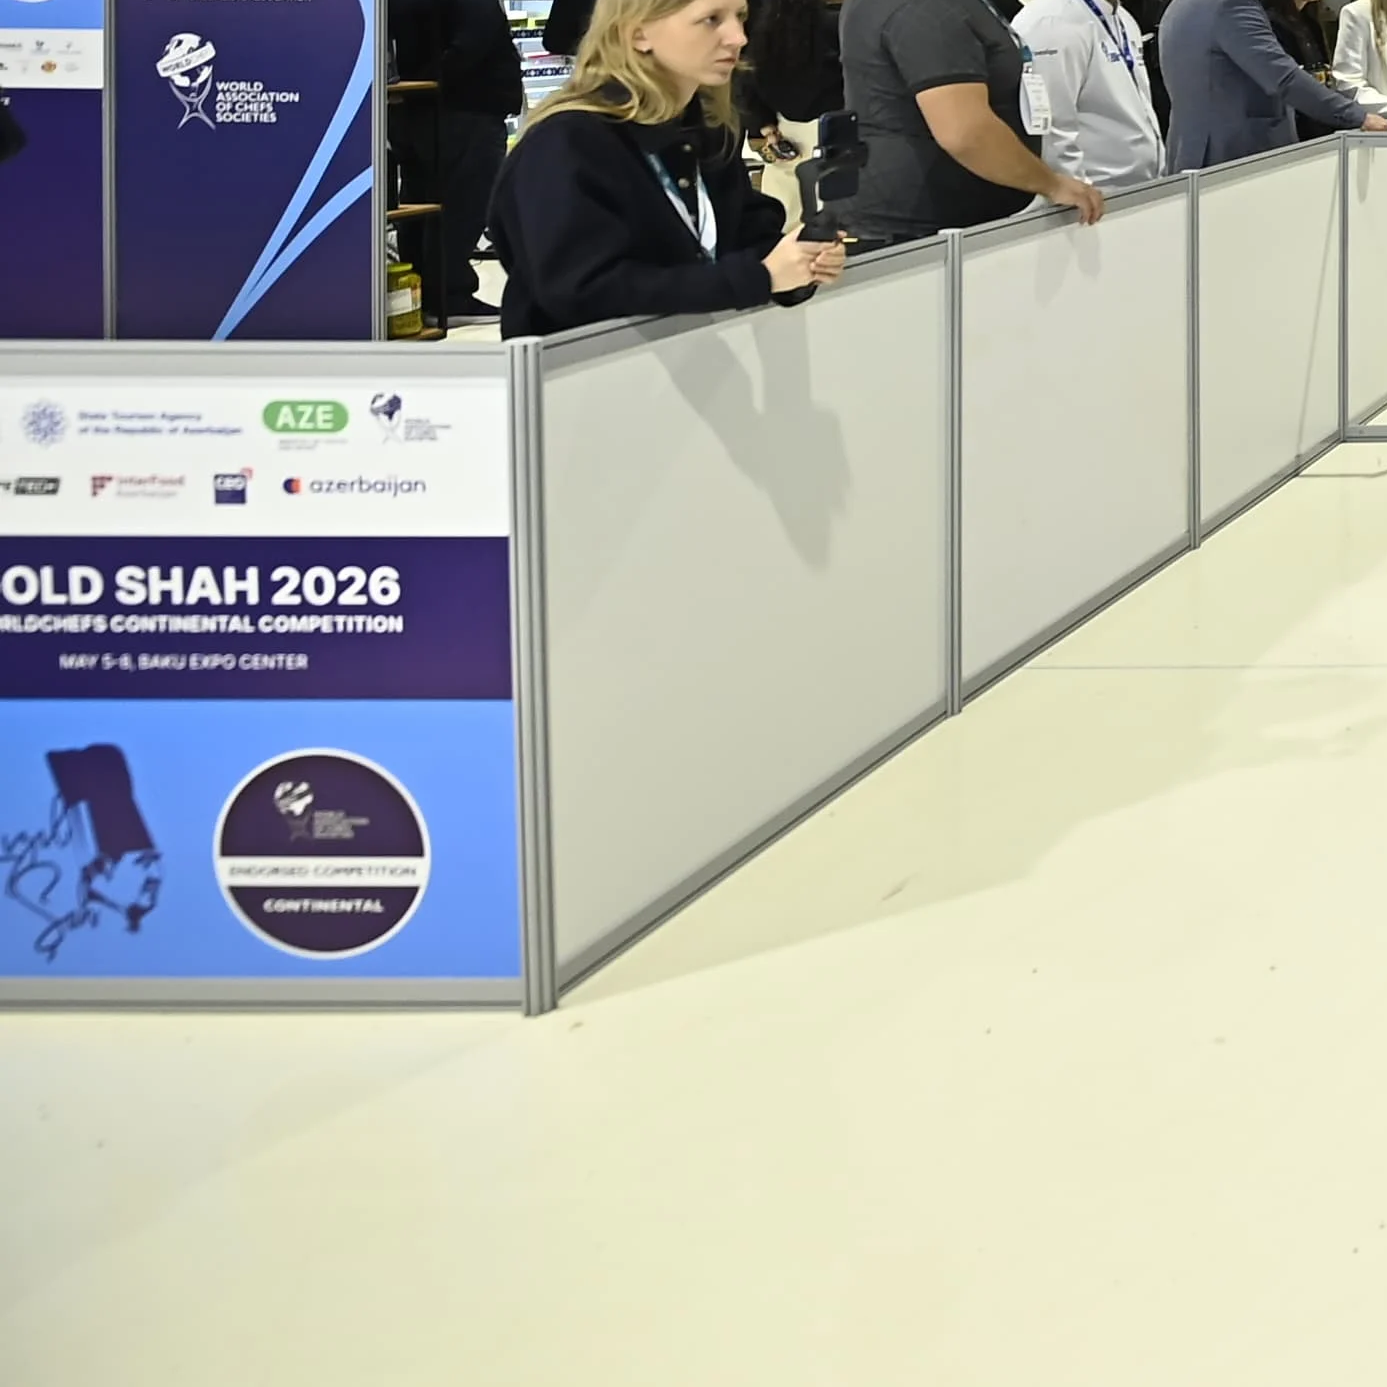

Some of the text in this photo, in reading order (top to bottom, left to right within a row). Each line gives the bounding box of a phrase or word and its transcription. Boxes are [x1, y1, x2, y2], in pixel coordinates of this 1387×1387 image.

[215, 82, 264, 92] WORLD
[215, 92, 300, 103] ASSOCIATION
[215, 102, 274, 113] OF CHEFS
[215, 112, 277, 124] SOCIETIES
[275, 404, 335, 430] AZE
[309, 475, 427, 497] azerbaijan
[114, 565, 260, 606] SHAH
[270, 565, 401, 606] 2026
[110, 615, 256, 633] CONTINENTAL
[258, 615, 404, 633] COMPETITION
[59, 653, 99, 670] MAY
[138, 653, 187, 670] BAKU
[189, 653, 237, 670] EXPO
[239, 653, 308, 670] CENTER
[229, 865, 417, 876] ENDORSED COMPETITION
[263, 898, 384, 913] CONTINENTAL
